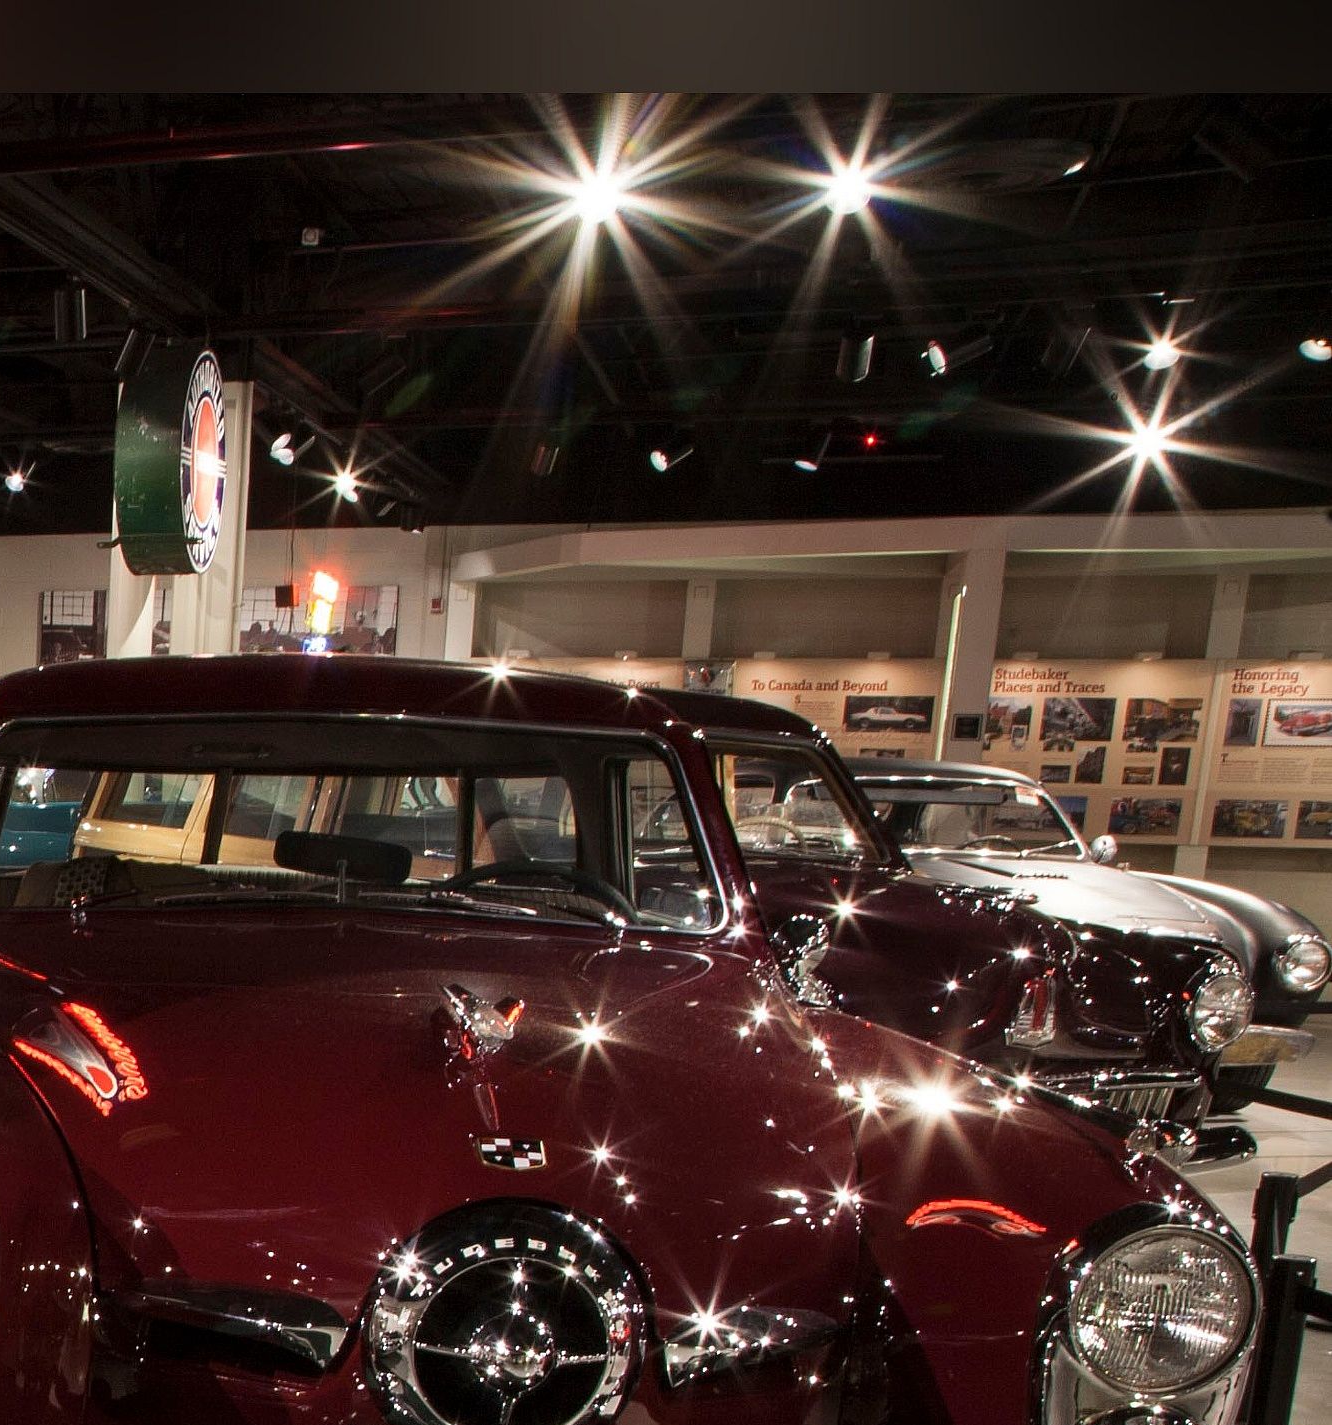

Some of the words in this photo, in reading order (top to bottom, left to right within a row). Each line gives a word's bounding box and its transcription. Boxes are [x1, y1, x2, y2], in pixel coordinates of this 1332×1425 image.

[994, 668, 1069, 680] Studebaker
[1233, 668, 1300, 683] Honoring
[751, 680, 765, 691] To
[768, 679, 813, 691] Canada
[815, 679, 839, 691] and
[842, 679, 888, 694] Beyond
[993, 680, 1032, 693] Places
[1036, 681, 1061, 693] and
[1064, 681, 1106, 693] Traces
[1231, 683, 1254, 694] the
[1260, 682, 1310, 697] Legacy
